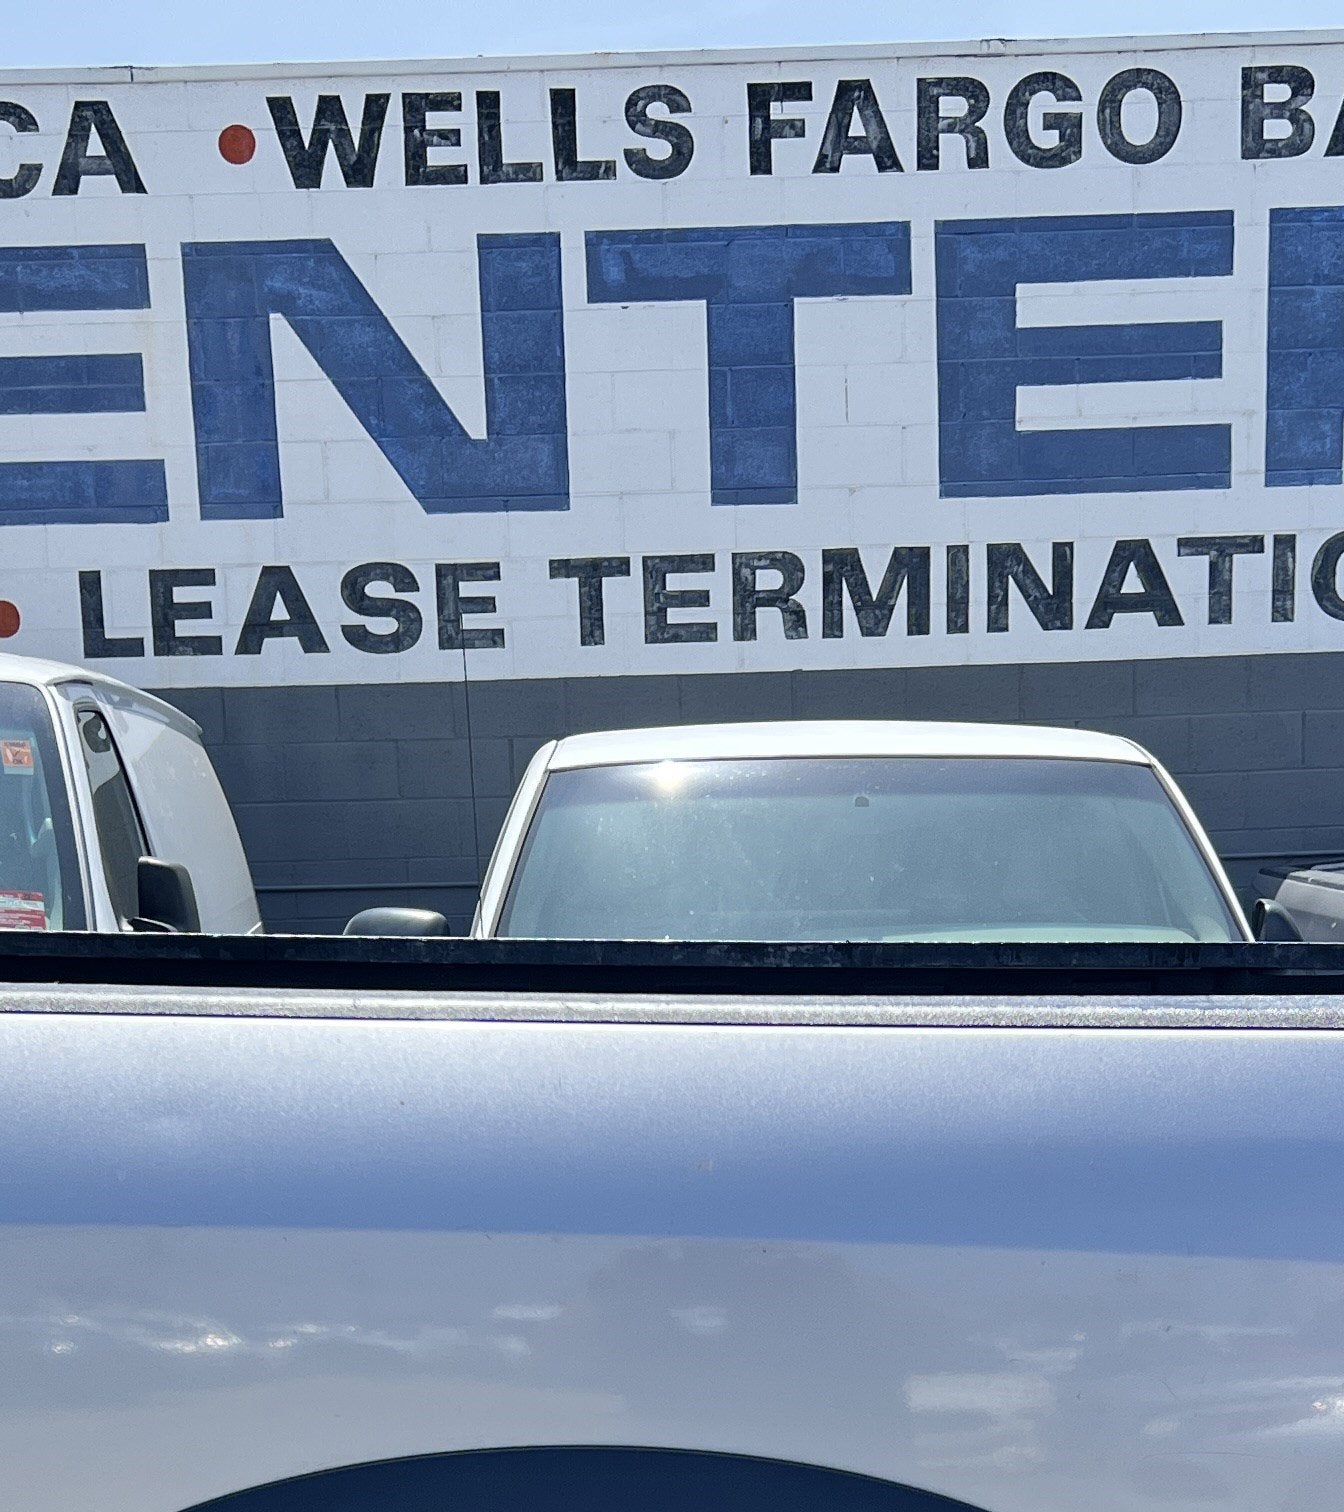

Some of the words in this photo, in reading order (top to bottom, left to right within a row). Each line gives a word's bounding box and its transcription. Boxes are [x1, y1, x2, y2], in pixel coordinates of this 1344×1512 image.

[266, 85, 694, 189] WELLS
[747, 68, 1183, 175] FARGO
[78, 562, 506, 660] LEASE
